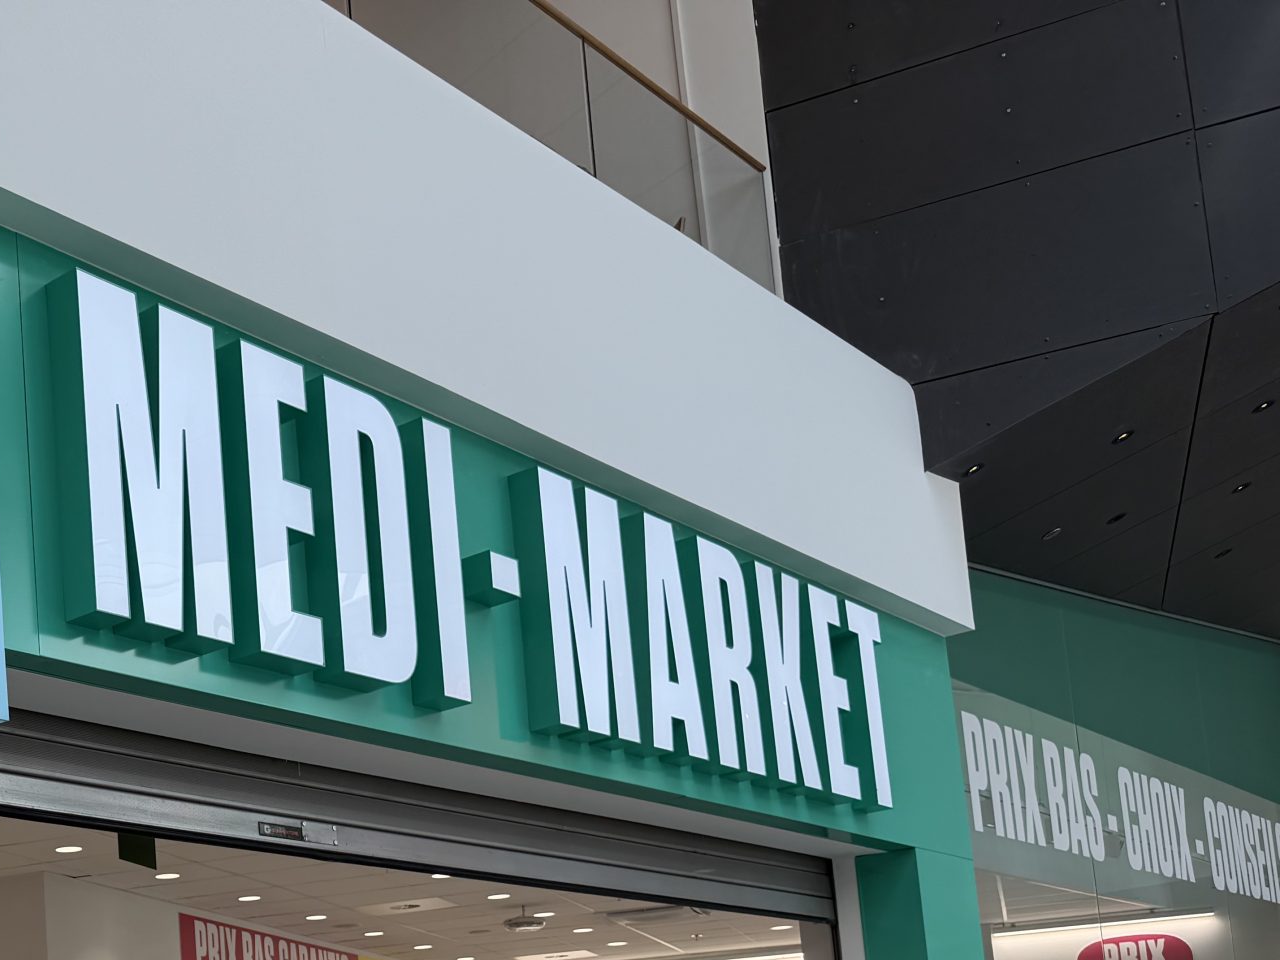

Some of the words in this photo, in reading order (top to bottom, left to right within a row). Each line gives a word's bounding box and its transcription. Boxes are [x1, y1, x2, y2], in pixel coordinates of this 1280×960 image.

[961, 711, 1046, 847] PRIX
[1041, 738, 1105, 862] BAS
[1118, 766, 1196, 883] CHOIX
